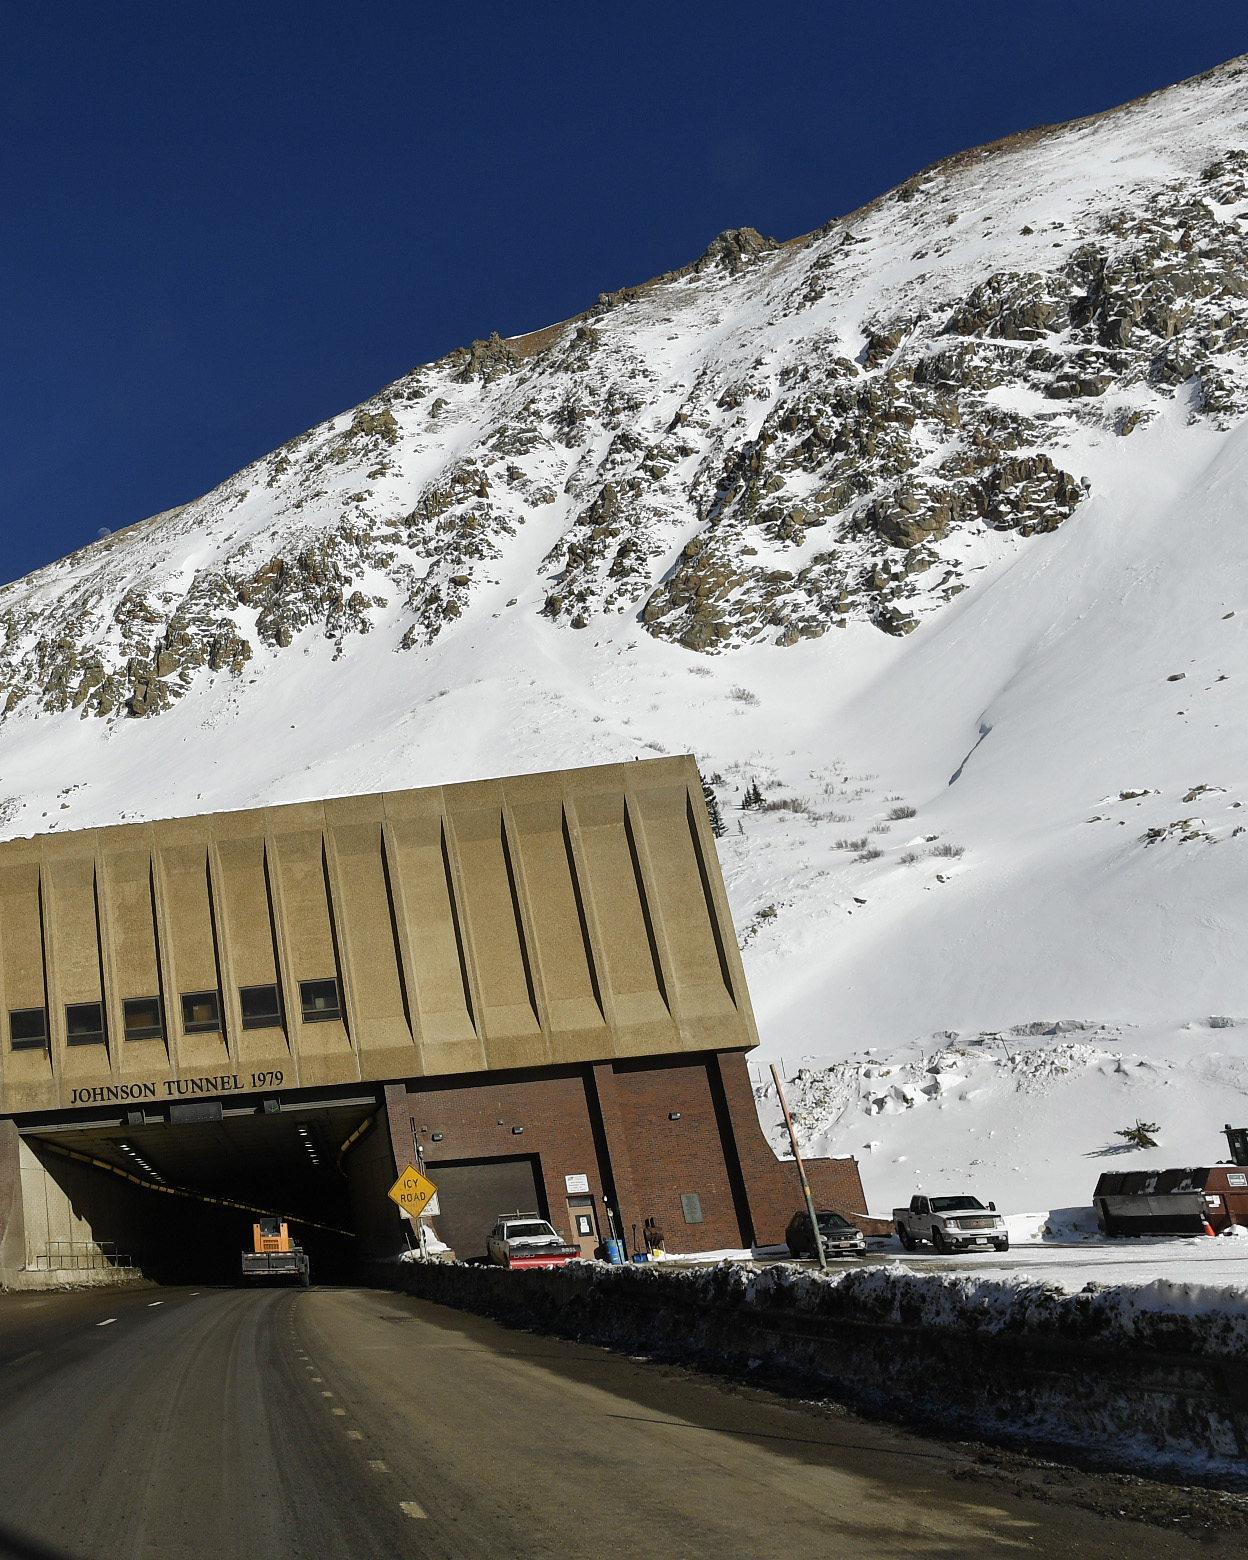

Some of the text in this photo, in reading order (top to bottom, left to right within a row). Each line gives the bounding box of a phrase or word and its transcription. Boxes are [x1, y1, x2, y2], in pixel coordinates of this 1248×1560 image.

[70, 1070, 284, 1104] JOHNSON TUNNEL 1979
[403, 1179, 419, 1189] ICY
[400, 1192, 426, 1203] ROAD
